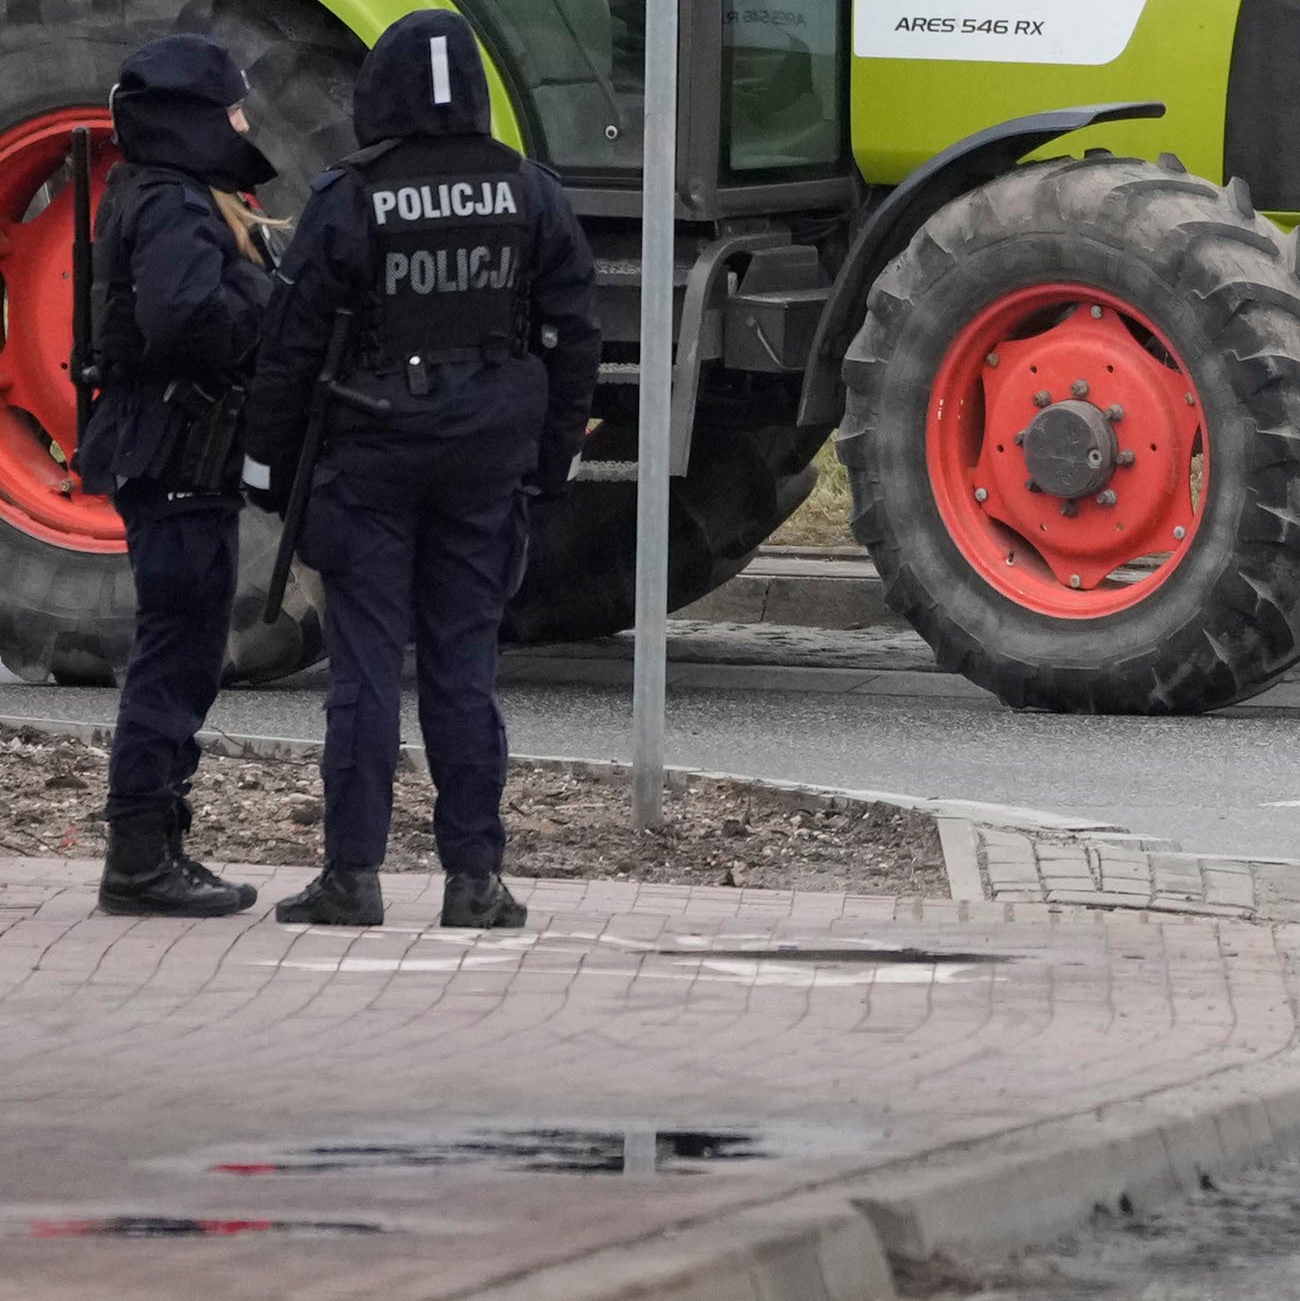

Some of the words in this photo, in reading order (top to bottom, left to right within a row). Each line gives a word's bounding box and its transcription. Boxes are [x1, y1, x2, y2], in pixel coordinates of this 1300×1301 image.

[895, 16, 956, 33] ARES
[961, 18, 1009, 35] 546
[1014, 20, 1045, 36] RX
[372, 181, 517, 225] POLICJA
